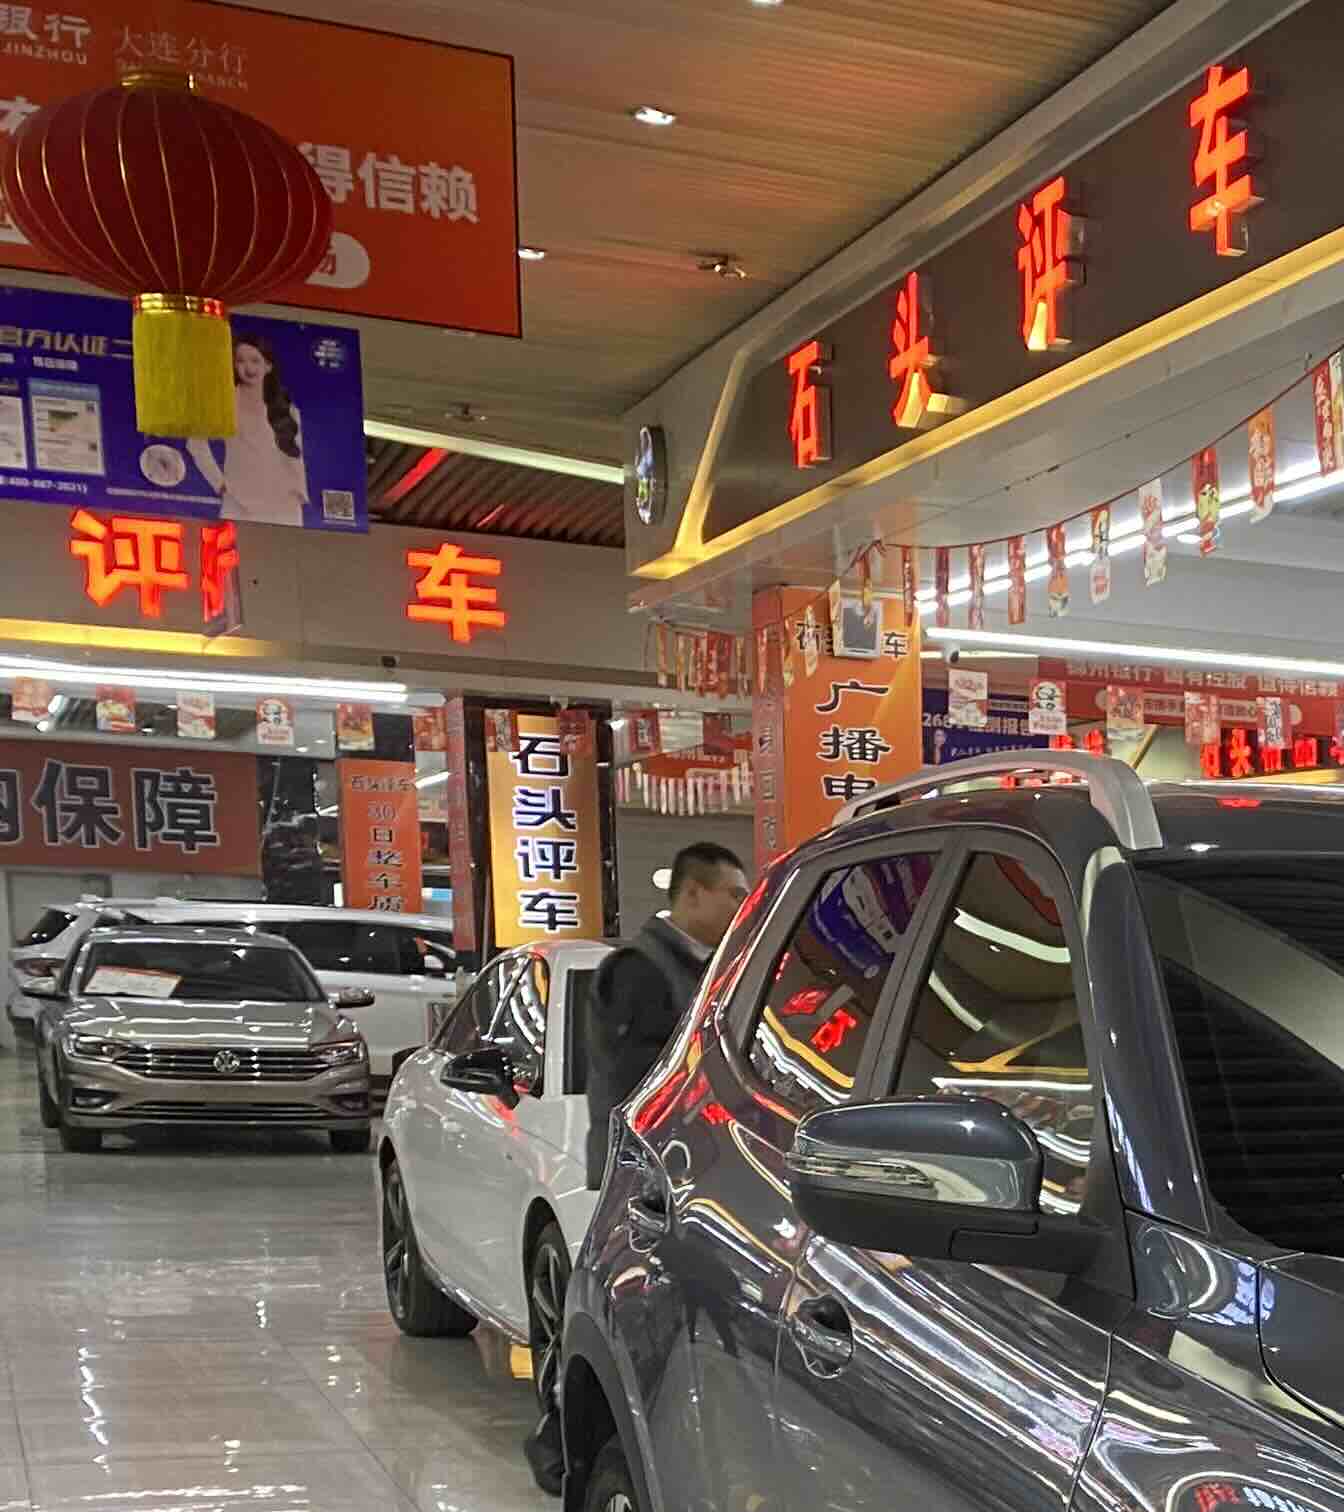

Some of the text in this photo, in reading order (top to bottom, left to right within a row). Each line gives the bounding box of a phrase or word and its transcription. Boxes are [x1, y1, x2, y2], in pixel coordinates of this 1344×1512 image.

[117, 25, 249, 74] 大连分行
[0, 757, 221, 855] 保障
[512, 733, 581, 933] 石头评车
